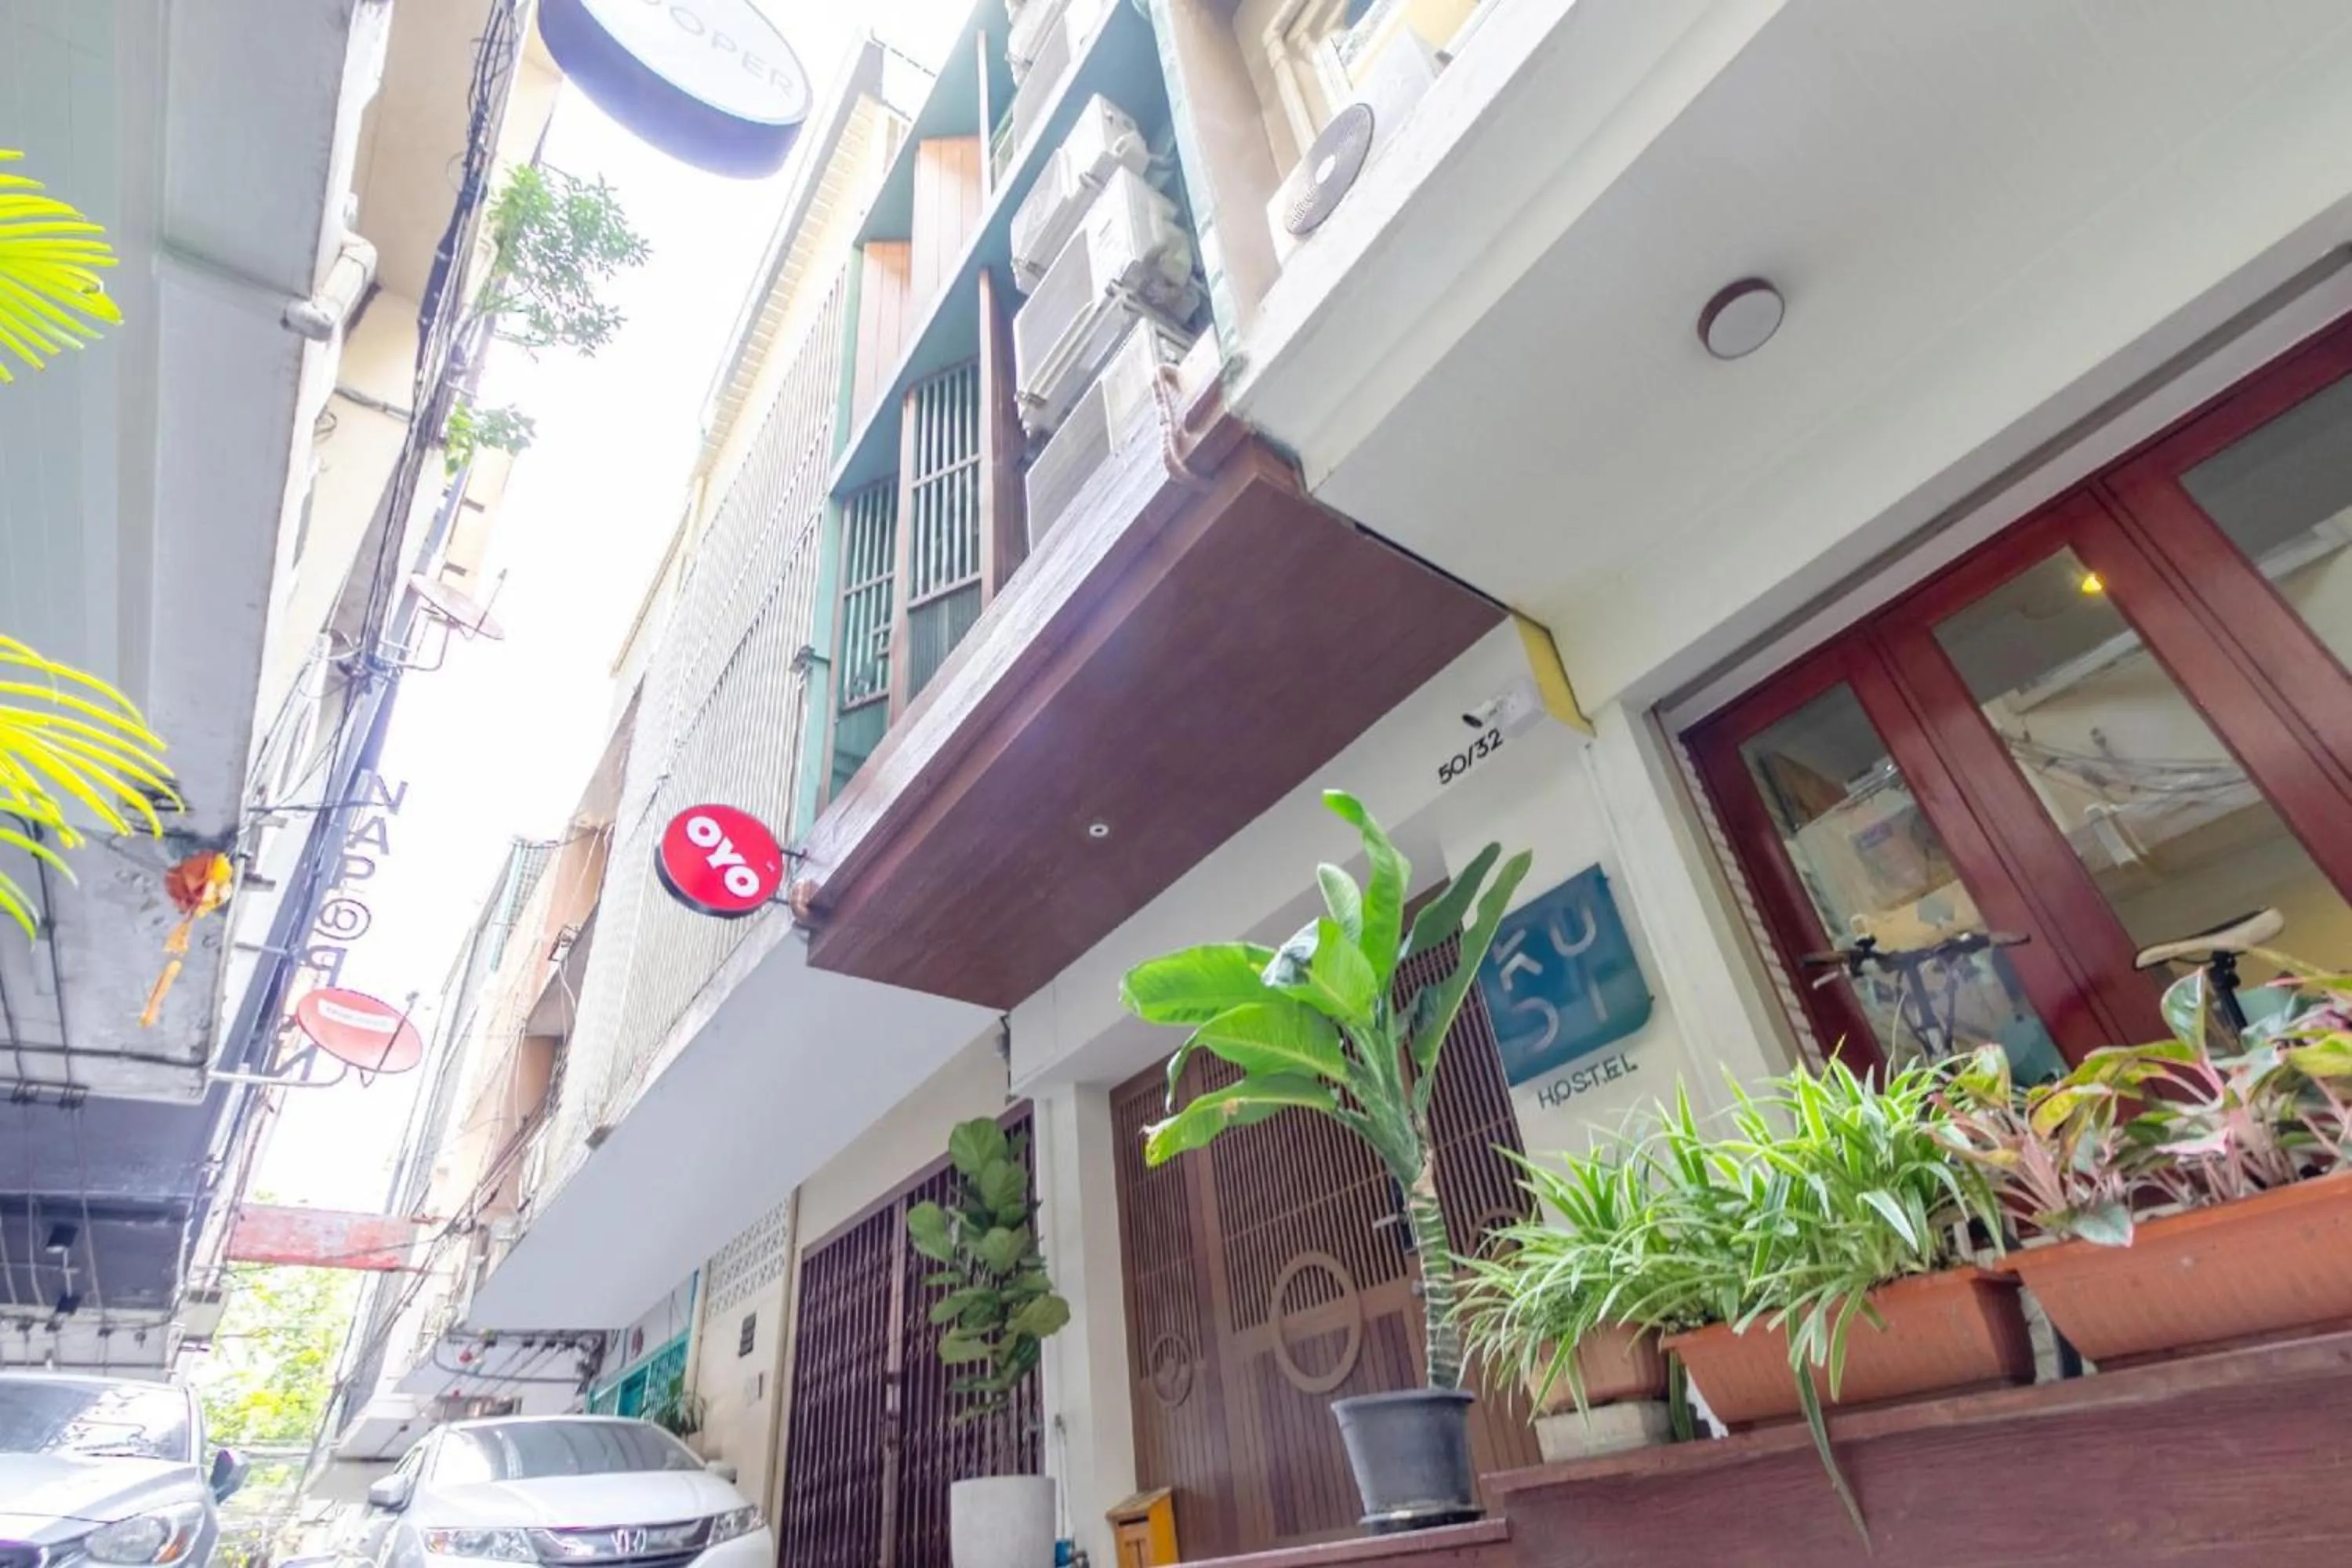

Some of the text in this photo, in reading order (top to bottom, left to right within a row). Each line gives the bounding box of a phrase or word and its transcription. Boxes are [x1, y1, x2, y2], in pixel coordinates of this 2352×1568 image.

[1438, 728, 1504, 784] 50/32
[685, 815, 760, 898] OYO
[1537, 1053, 1639, 1110] HOSTEL
